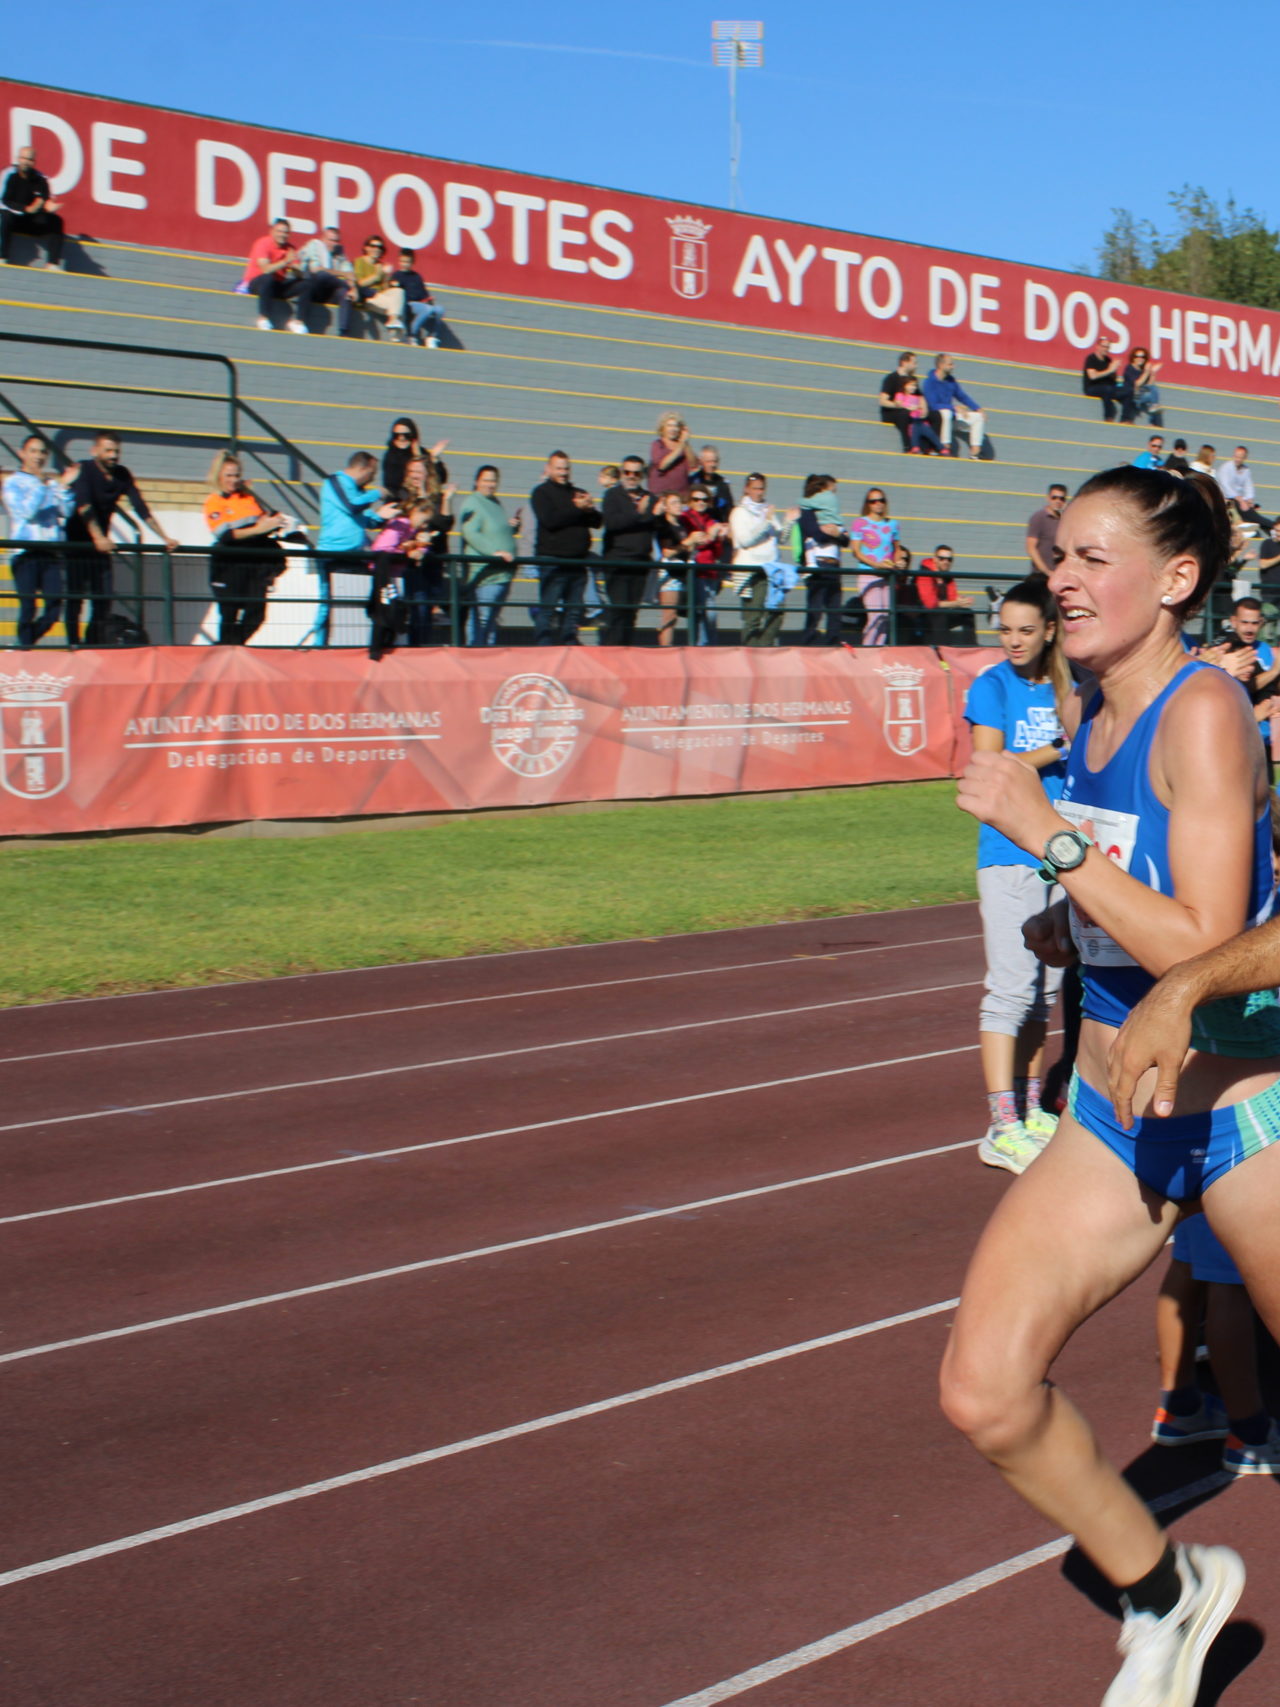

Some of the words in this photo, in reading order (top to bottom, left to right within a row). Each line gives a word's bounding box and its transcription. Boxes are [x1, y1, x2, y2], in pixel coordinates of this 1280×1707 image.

[10, 107, 147, 210] DE
[195, 138, 634, 280] DEPORTES
[732, 234, 907, 322] AYTO.
[928, 266, 1000, 335] DE
[1023, 279, 1130, 350] DOS
[124, 713, 280, 735] AYUNTAMIENTO
[283, 713, 305, 730] DE
[308, 712, 346, 730] DOS
[349, 711, 442, 729] HERMANAS
[621, 704, 732, 721] AYUNTAMIENTO
[733, 704, 752, 718] DE
[753, 703, 779, 718] DOS
[167, 748, 283, 769] Delegación
[291, 747, 315, 763] de
[320, 746, 407, 764] Deportes
